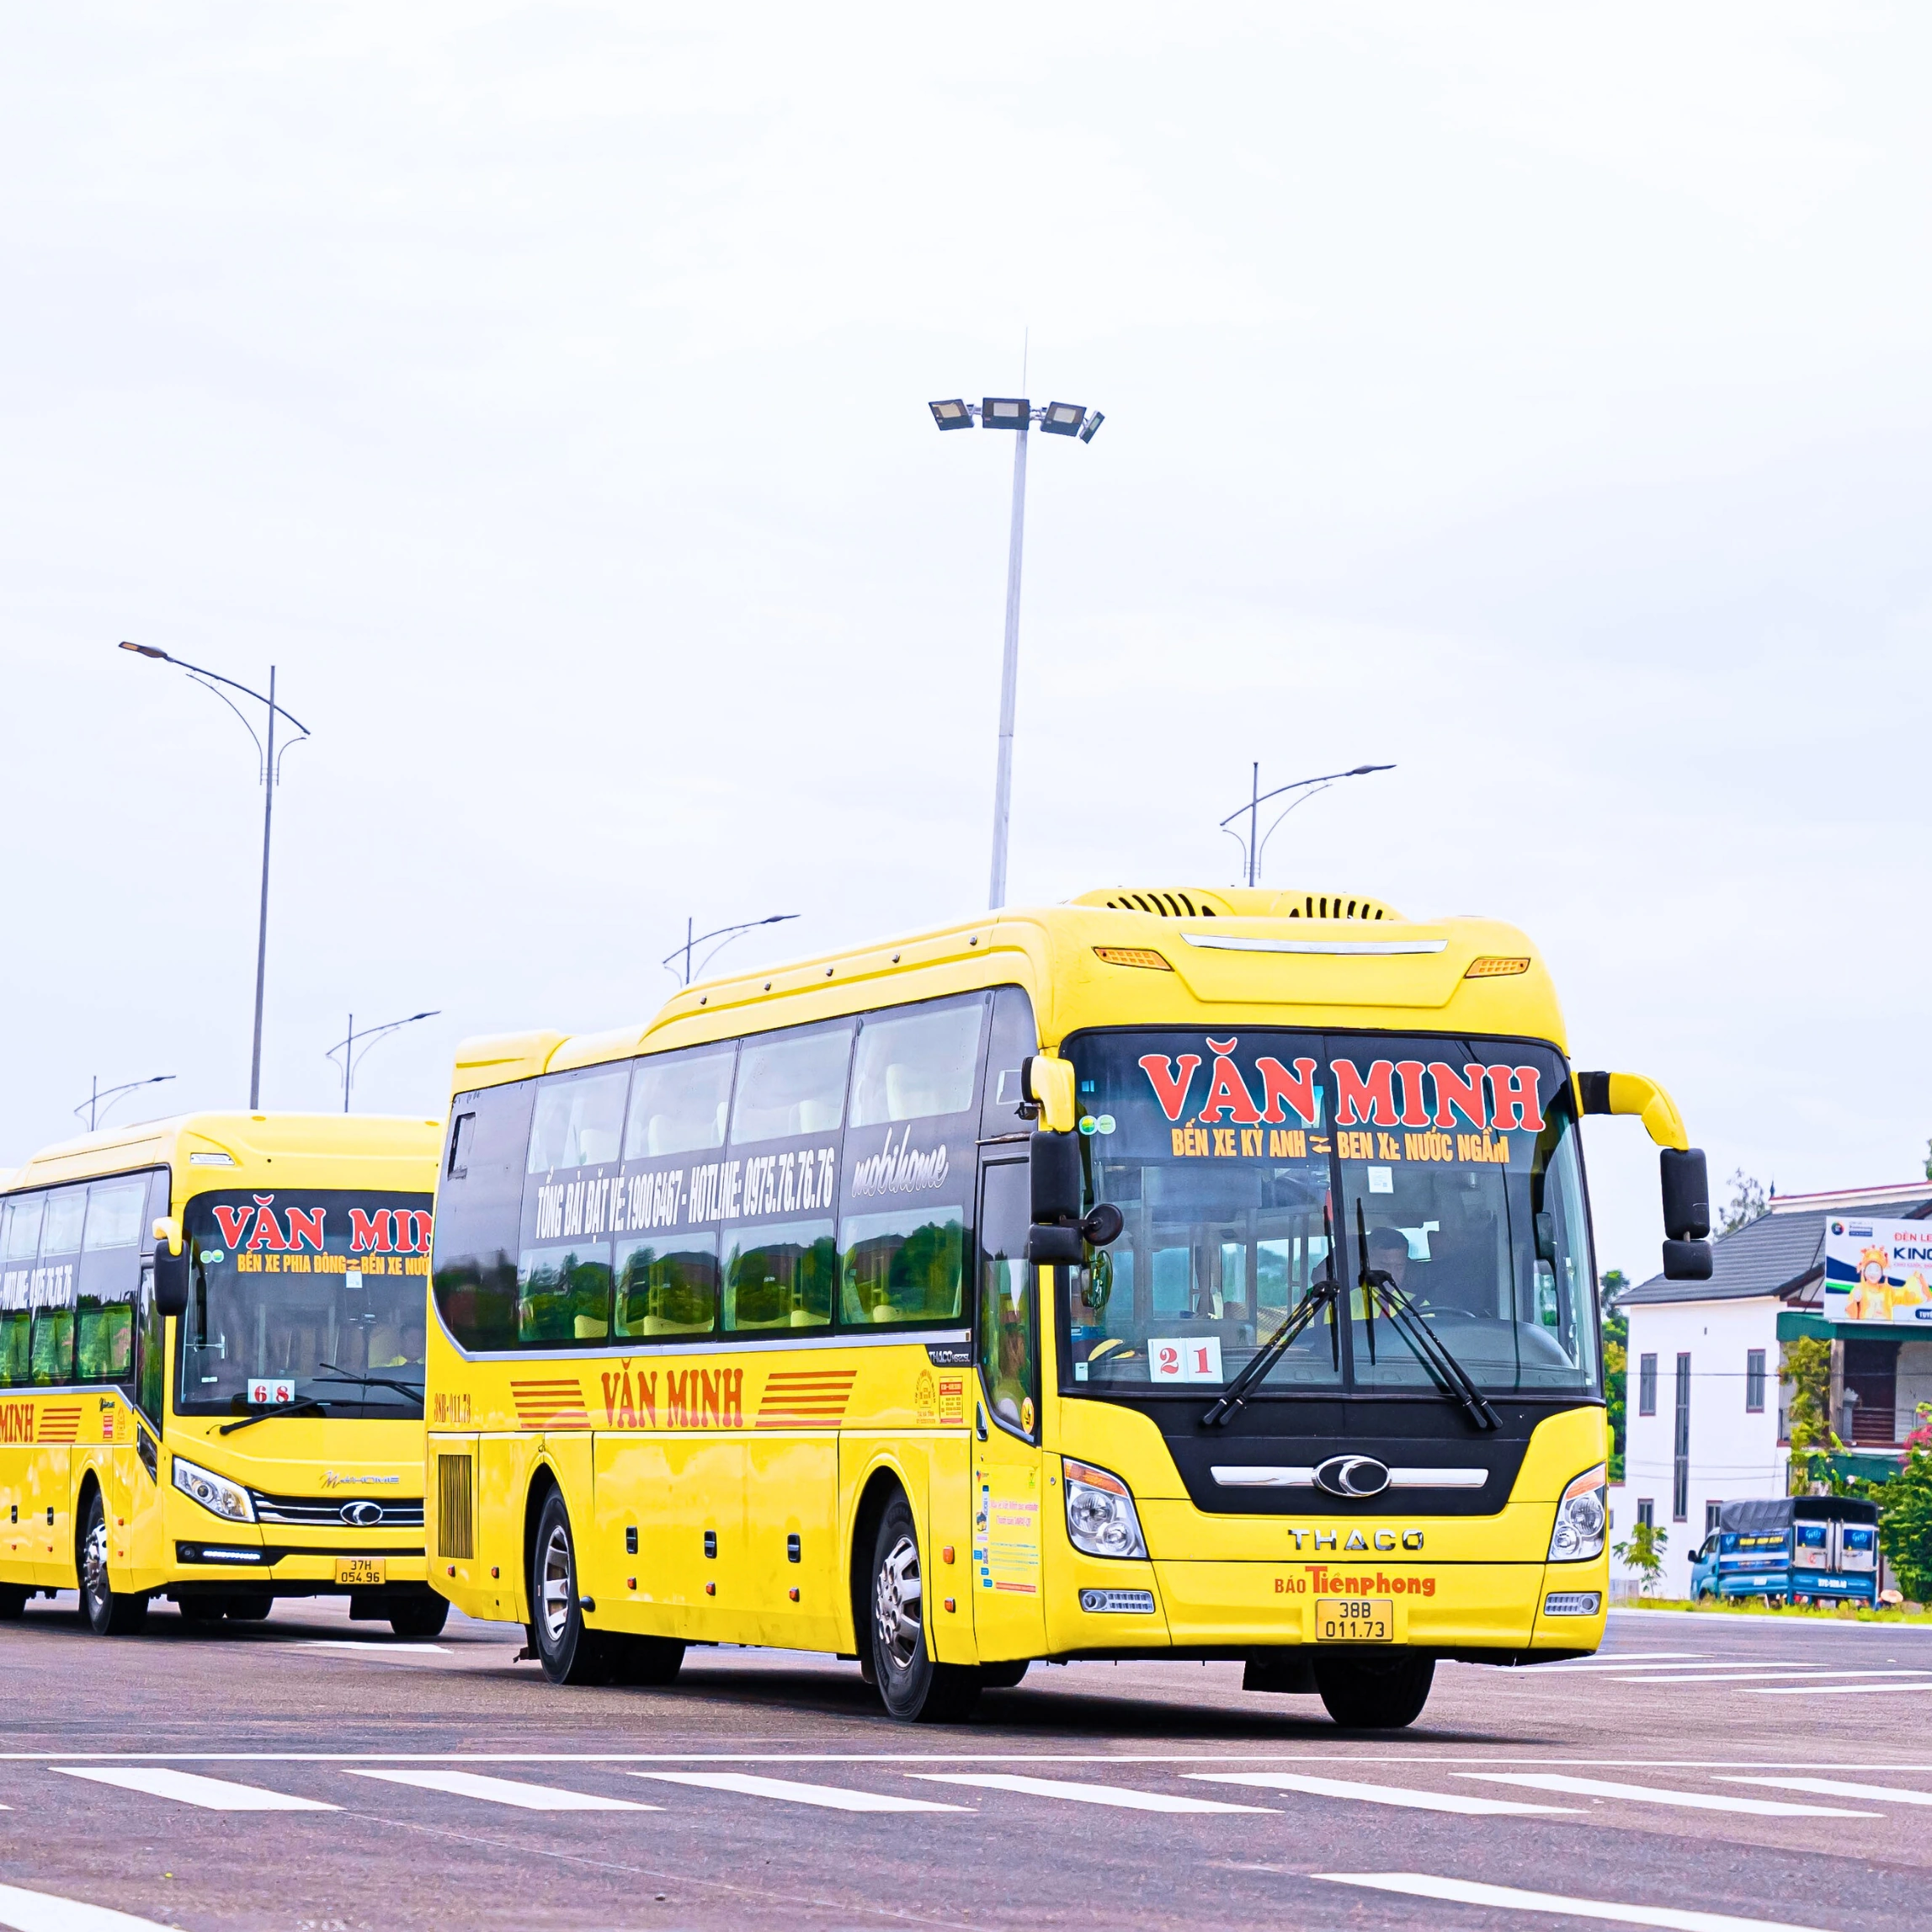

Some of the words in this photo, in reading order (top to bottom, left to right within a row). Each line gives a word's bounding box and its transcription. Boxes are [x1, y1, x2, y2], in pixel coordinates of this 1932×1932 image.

[1139, 1036, 1318, 1124] VĂN
[1330, 1058, 1546, 1132] MINH
[1171, 1118, 1209, 1157] BẾN
[1212, 1129, 1237, 1157] XE
[1269, 1130, 1307, 1158] ANH
[1404, 1126, 1453, 1162] NƯỚC
[851, 1124, 950, 1198] mobihome
[688, 1160, 742, 1223] HOTLINE:
[742, 1147, 835, 1216] 0975.76.76.76
[212, 1194, 327, 1251] VĂN
[237, 1248, 262, 1273] BẾN
[264, 1253, 280, 1273] XE
[313, 1251, 347, 1275] ĐÔNG
[360, 1250, 385, 1275] BẾN
[387, 1256, 402, 1275] XE
[405, 1253, 429, 1276] NƯỚ
[601, 1357, 657, 1429] VĂN
[667, 1368, 743, 1429] MINH
[1288, 1529, 1424, 1551] THACO
[341, 1572, 380, 1583] 054.96
[350, 1560, 371, 1571] 37H
[1275, 1574, 1307, 1594] BÁO
[1339, 1602, 1371, 1618] 38B
[1326, 1621, 1385, 1637] 011.73
